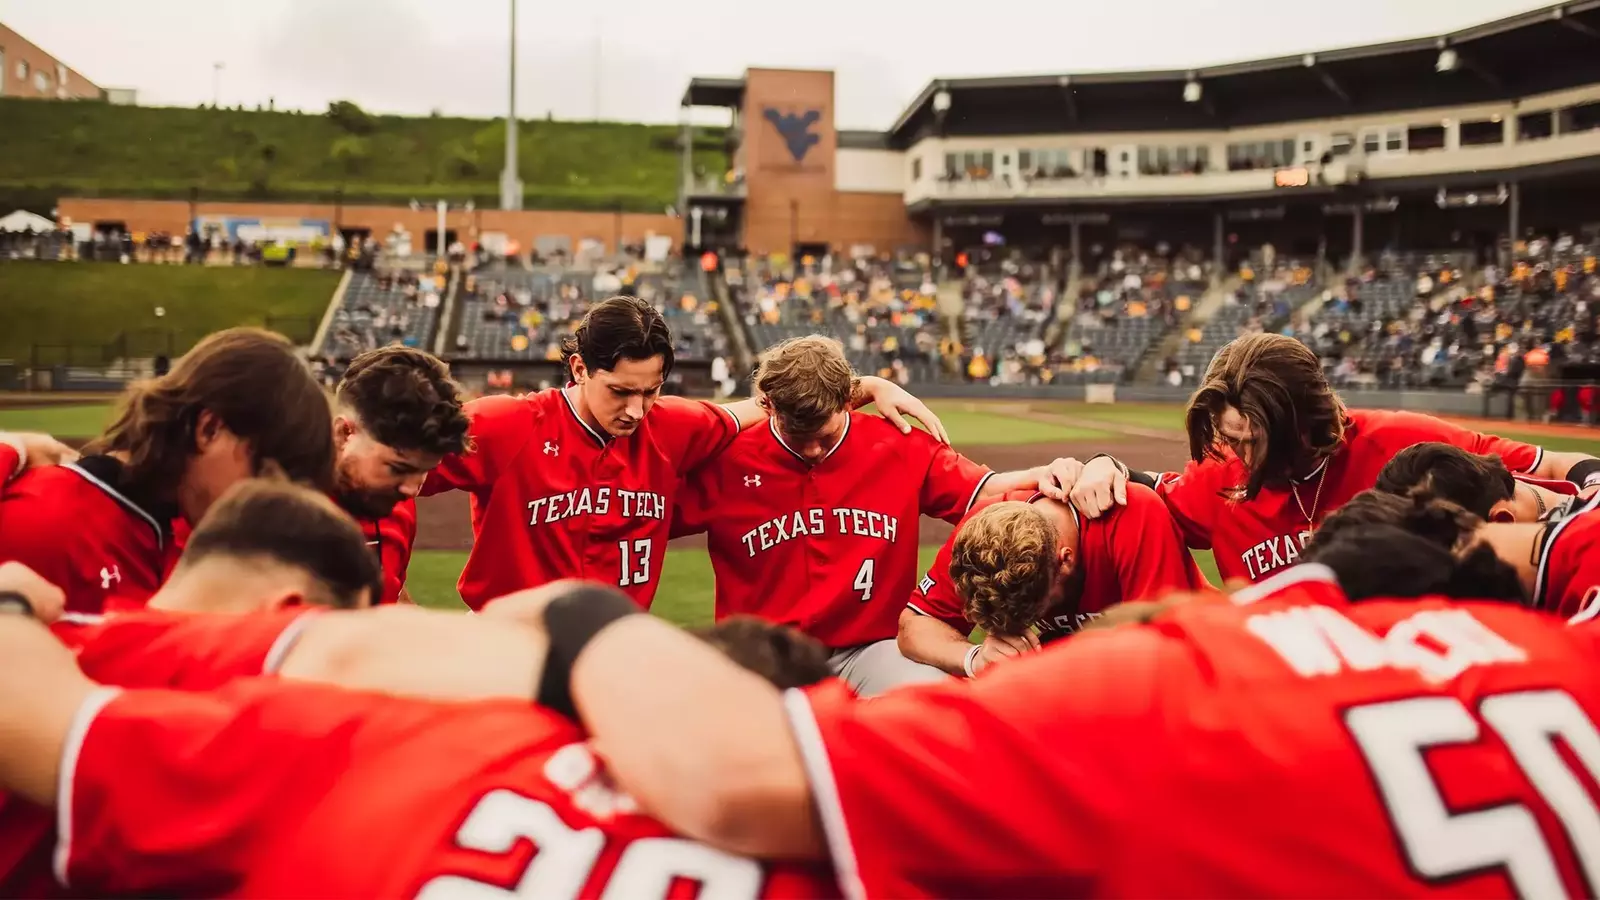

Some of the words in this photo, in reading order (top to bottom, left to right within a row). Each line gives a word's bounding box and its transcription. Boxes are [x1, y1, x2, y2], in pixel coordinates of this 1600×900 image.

[527, 487, 611, 526] TEXAS
[617, 489, 666, 520] TECH
[741, 508, 825, 557] TEXAS
[832, 507, 898, 543] TECH
[618, 538, 652, 587] 13
[853, 558, 875, 601] 4
